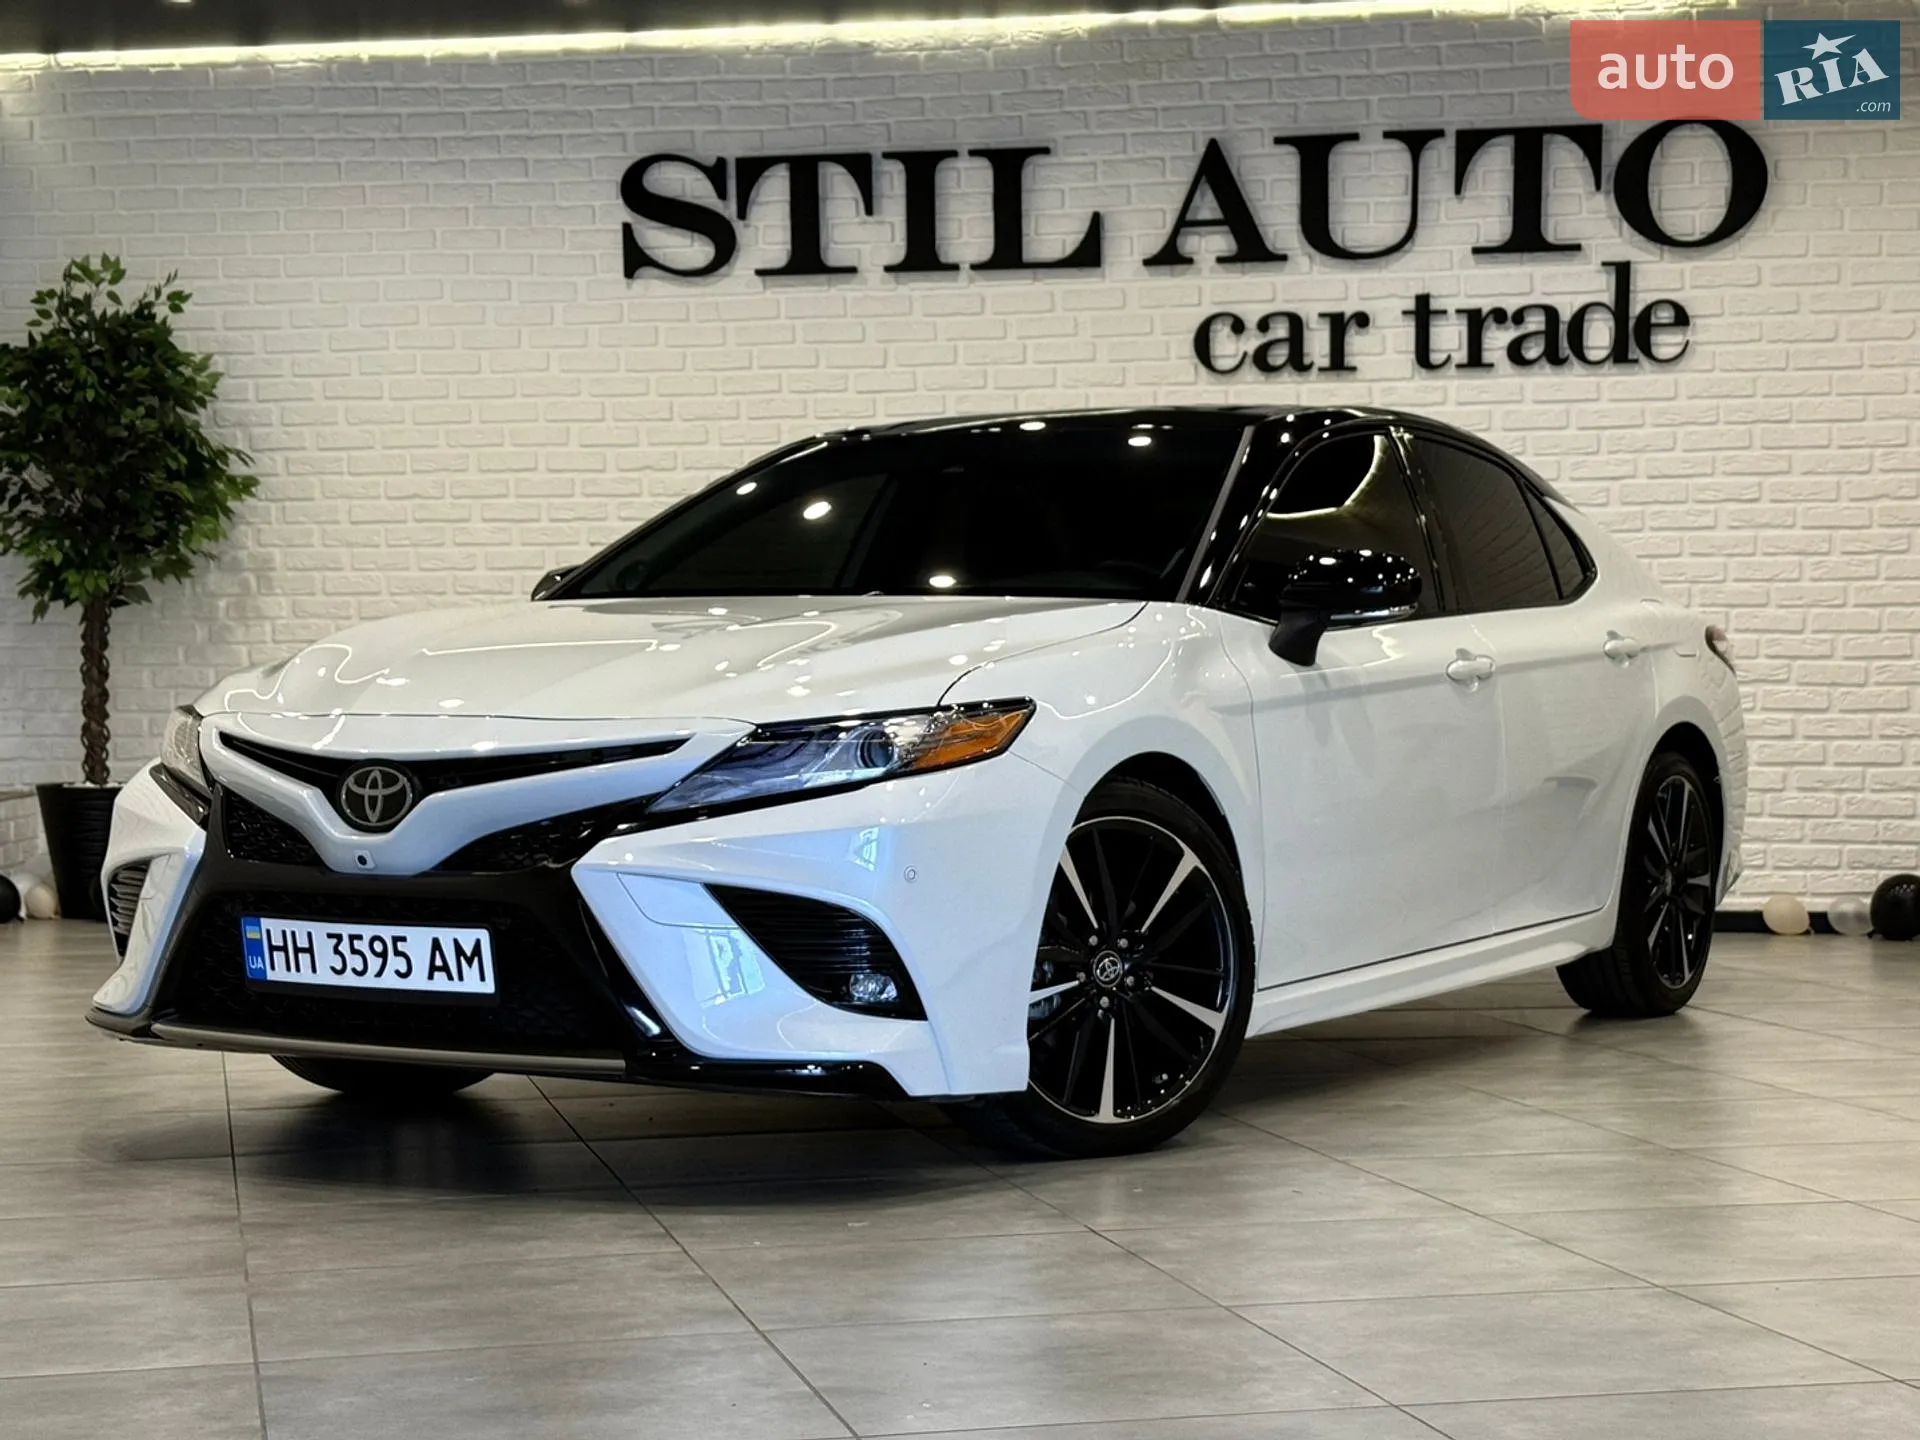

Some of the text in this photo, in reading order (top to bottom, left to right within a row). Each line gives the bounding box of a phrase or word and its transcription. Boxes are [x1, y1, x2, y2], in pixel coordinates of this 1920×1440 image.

[620, 119, 1769, 279] STIL AUTO
[1193, 260, 1691, 375] car trade
[249, 956, 264, 970] UA
[266, 928, 486, 982] HH 3595 AM
